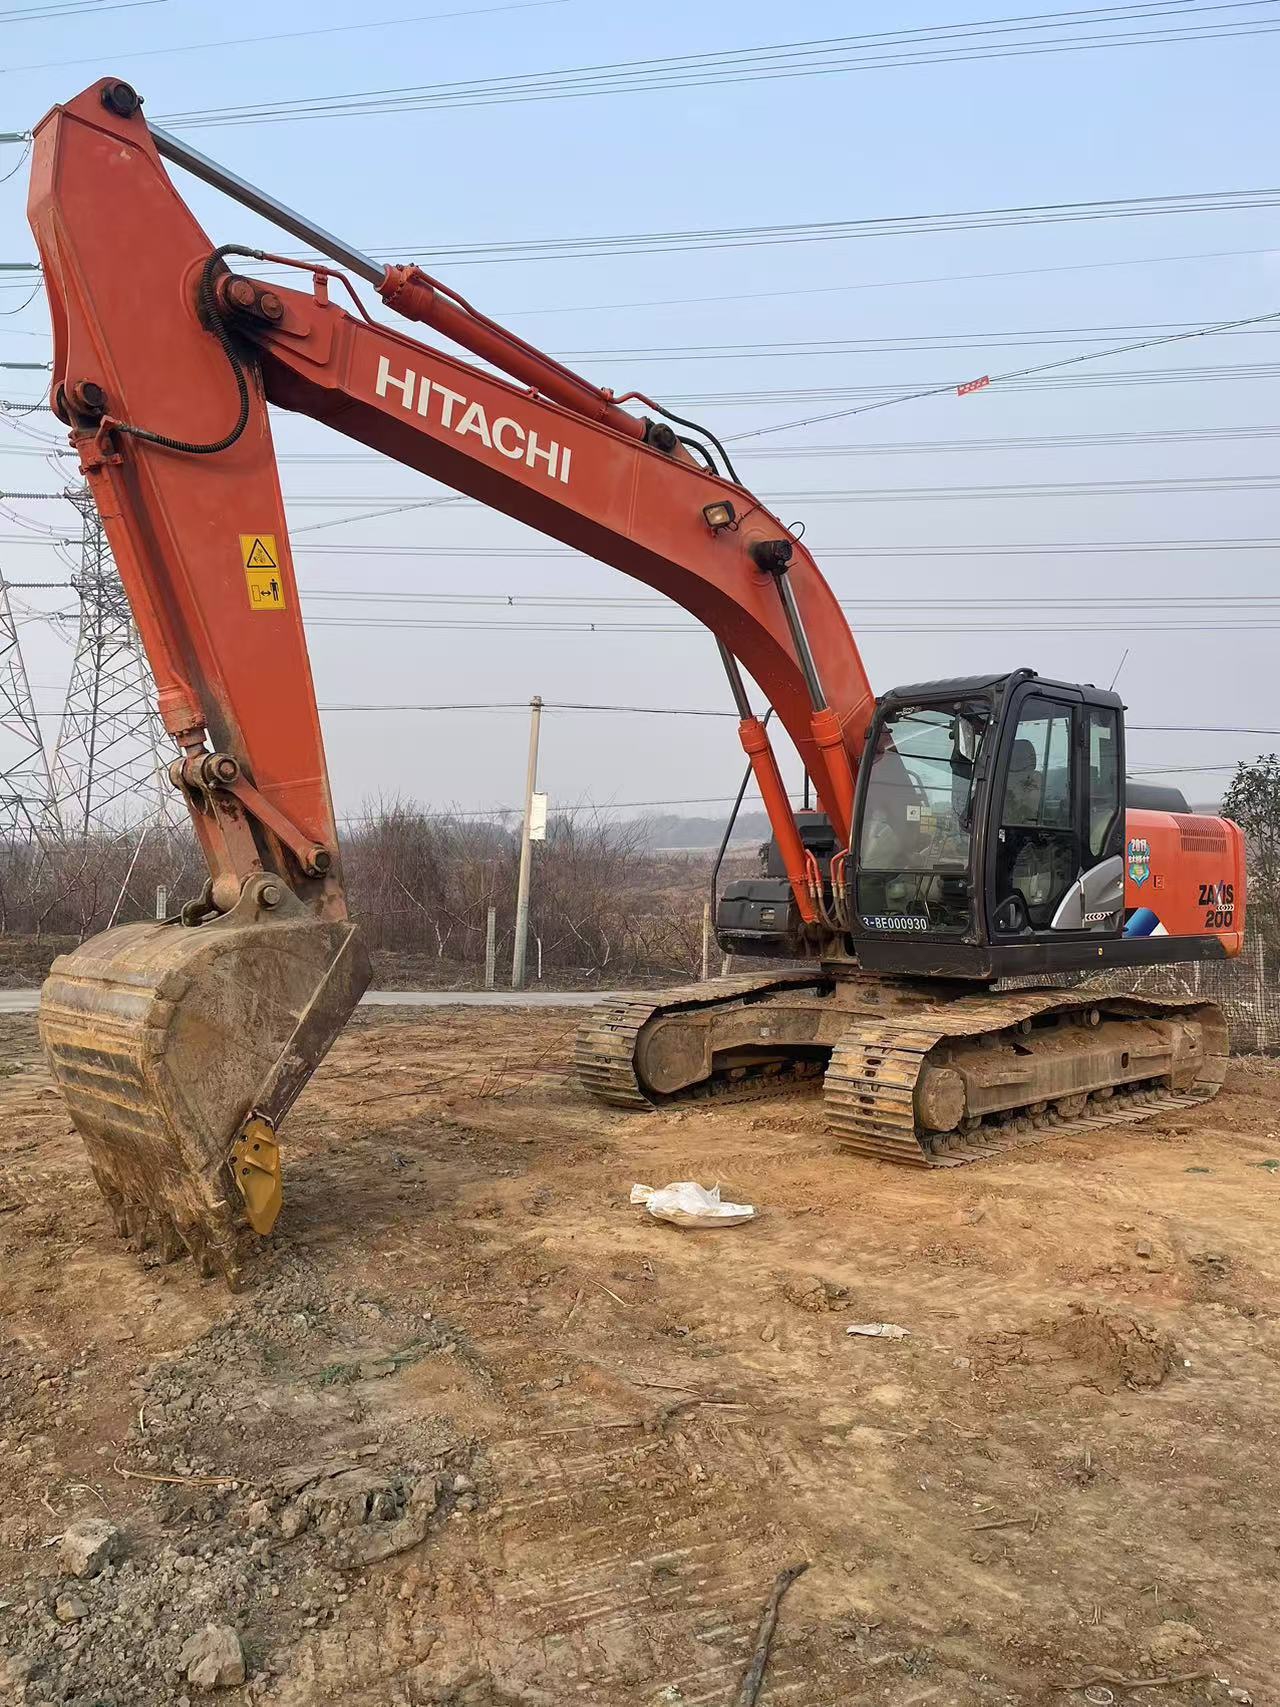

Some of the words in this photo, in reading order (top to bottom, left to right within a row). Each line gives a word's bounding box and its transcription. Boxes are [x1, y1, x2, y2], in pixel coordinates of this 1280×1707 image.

[375, 355, 572, 484] HITACHI
[1198, 880, 1234, 906] ZAXIS
[1205, 910, 1233, 928] 200
